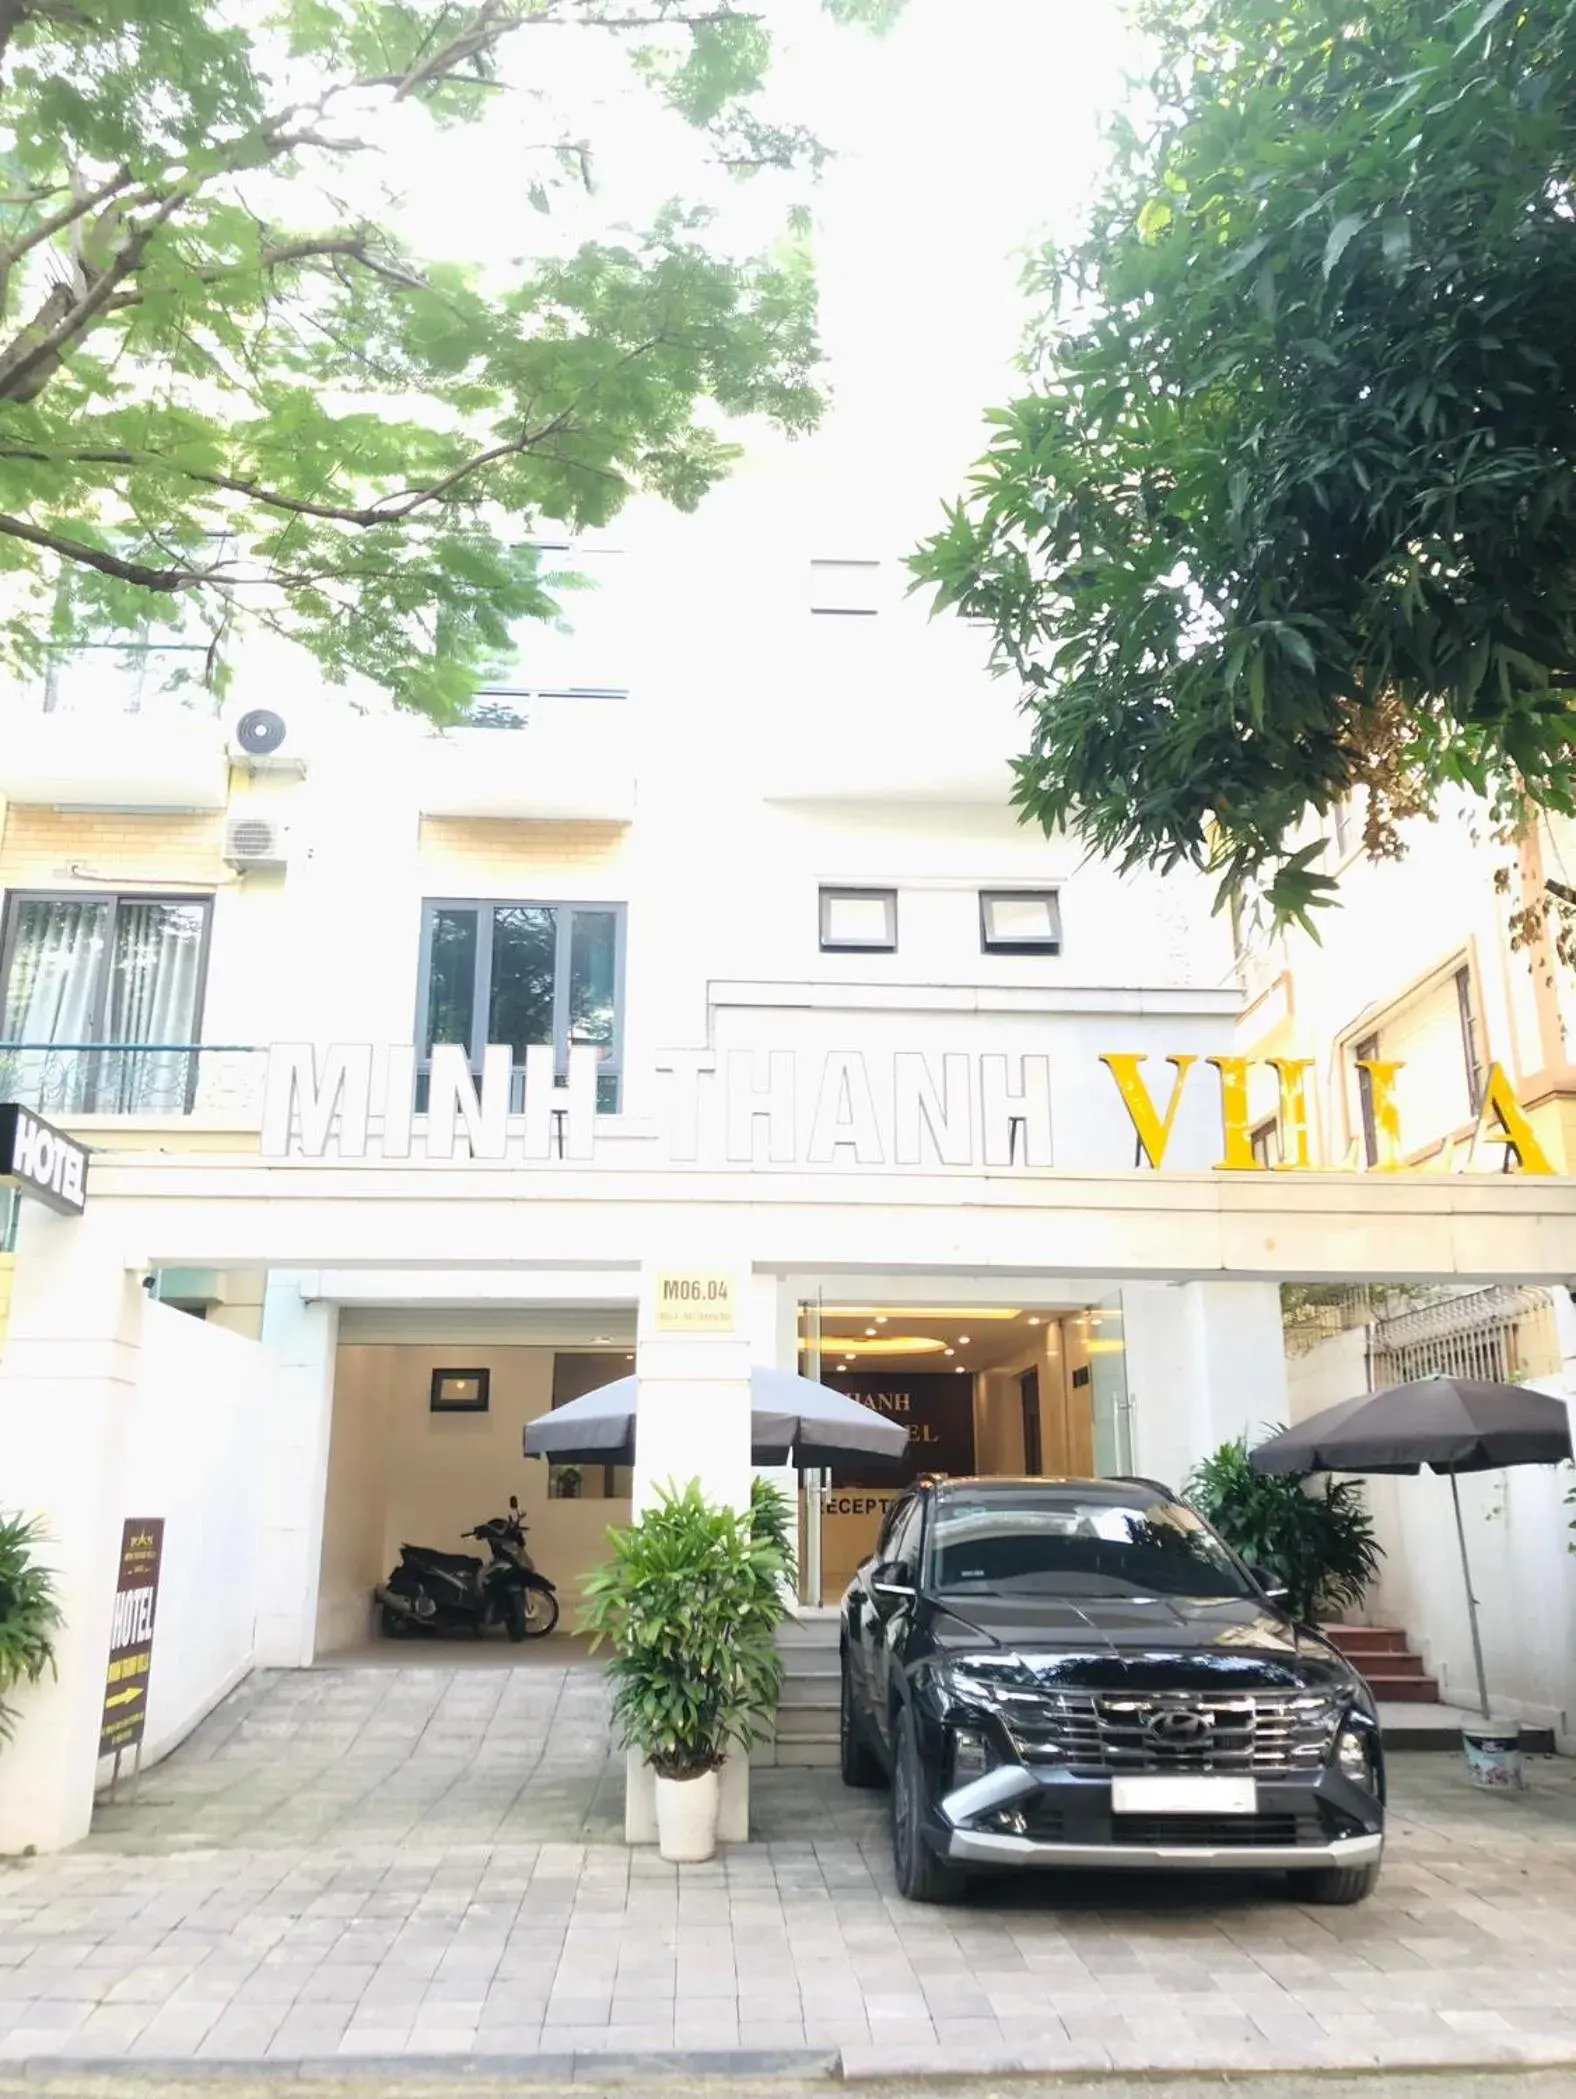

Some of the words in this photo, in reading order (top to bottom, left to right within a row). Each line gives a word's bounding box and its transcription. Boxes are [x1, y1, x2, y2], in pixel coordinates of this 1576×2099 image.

[260, 1041, 598, 1160] MINH
[655, 1048, 1054, 1167] THANH
[1098, 1053, 1557, 1175] VILLA
[12, 1112, 85, 1208] HOTEL
[663, 1279, 728, 1301] M06.04
[820, 1498, 889, 1515] ECEPT
[110, 1586, 154, 1650] HOTEL
